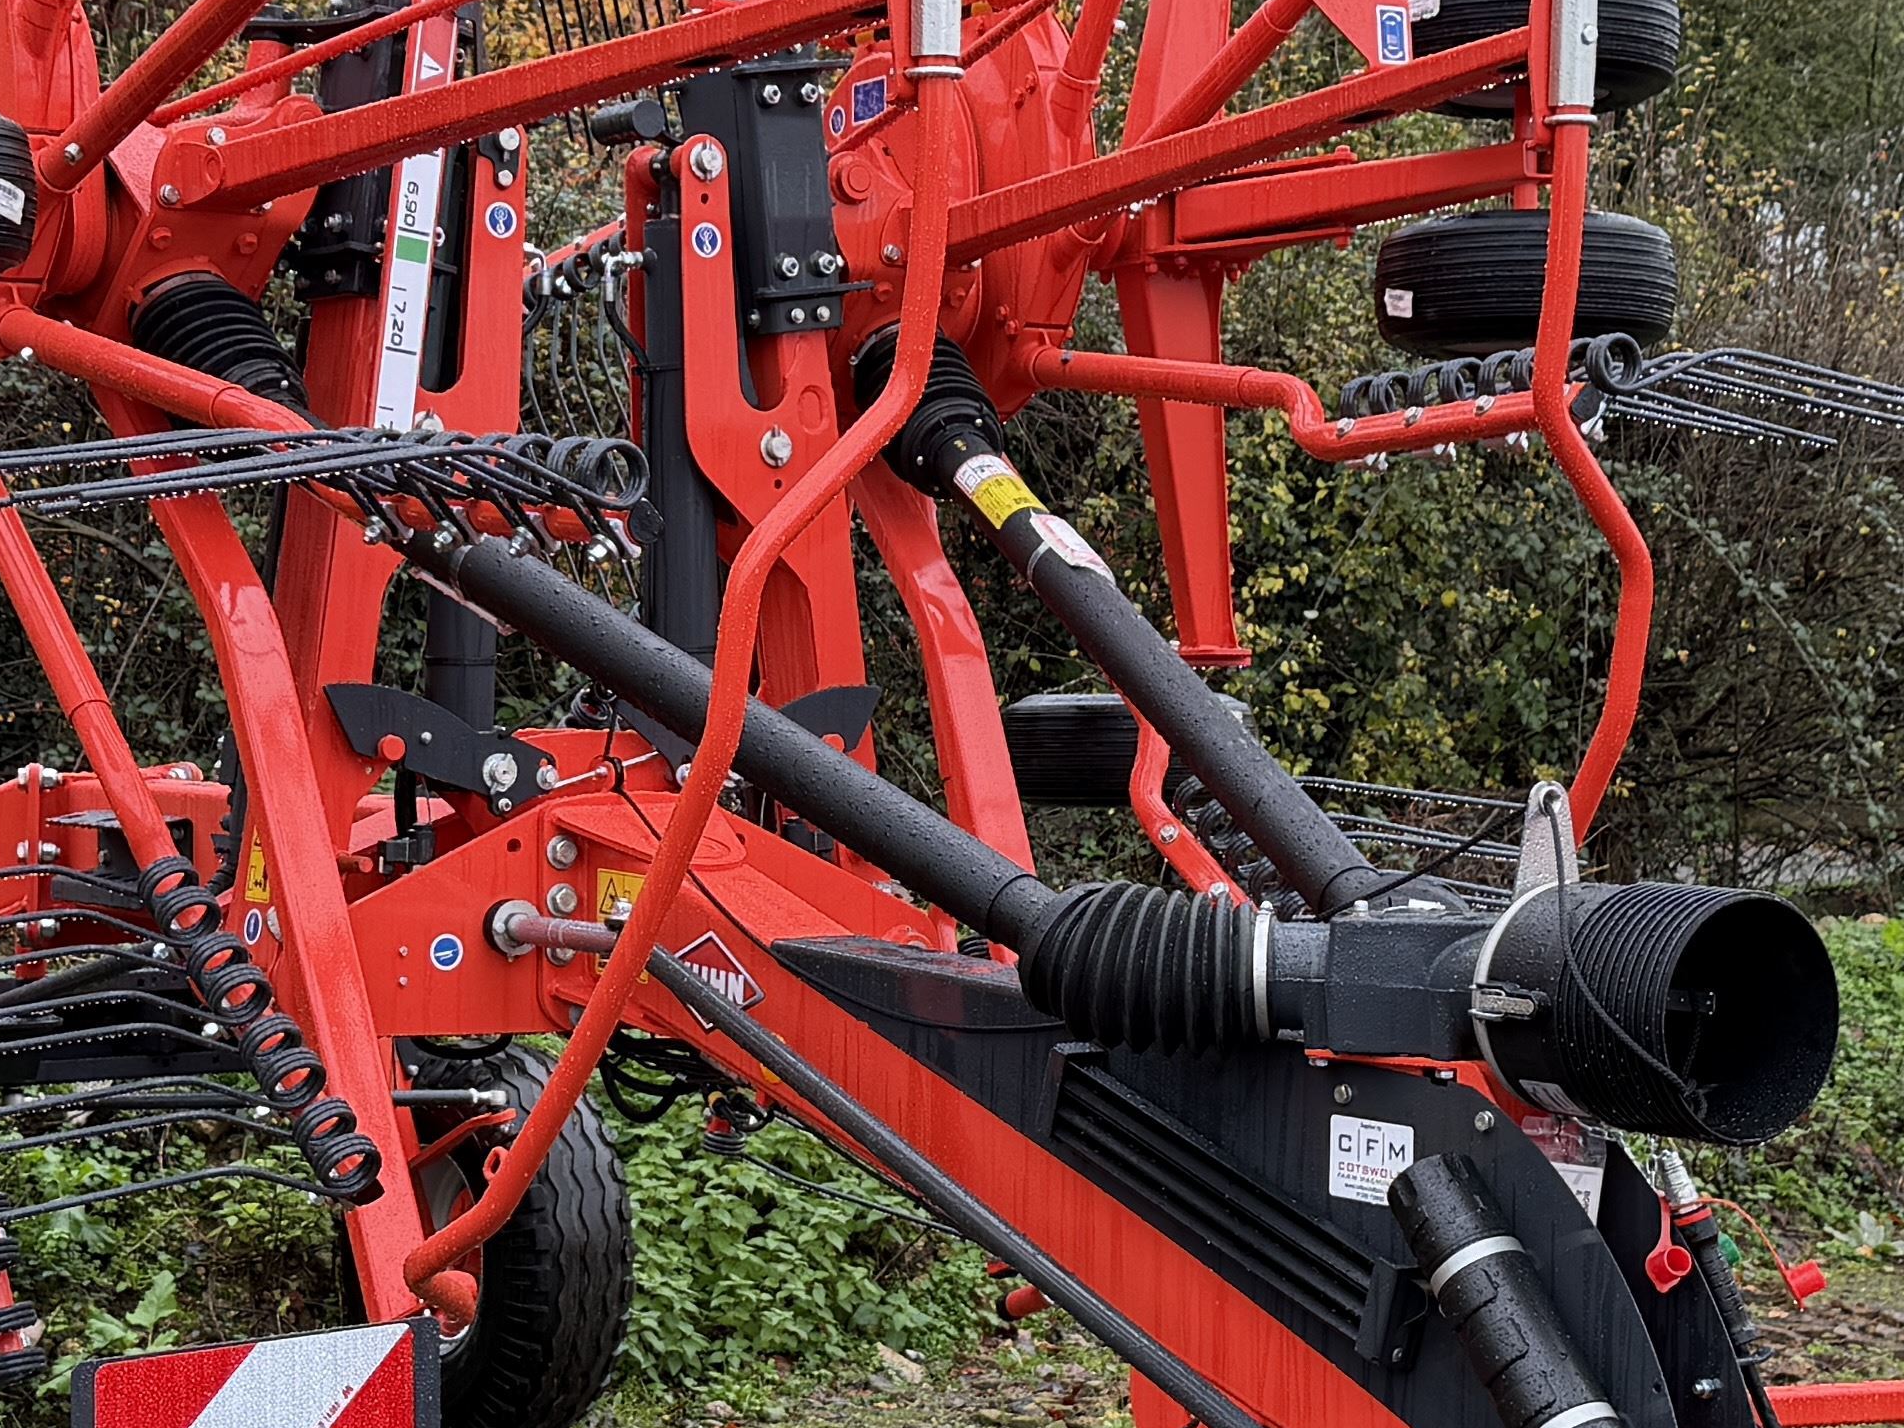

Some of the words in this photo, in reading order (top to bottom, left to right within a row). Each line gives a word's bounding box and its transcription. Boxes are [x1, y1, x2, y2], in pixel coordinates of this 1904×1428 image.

[404, 180, 420, 227] 6,90
[390, 300, 407, 347] 7,20
[1338, 1161, 1395, 1179] COTSWOL
